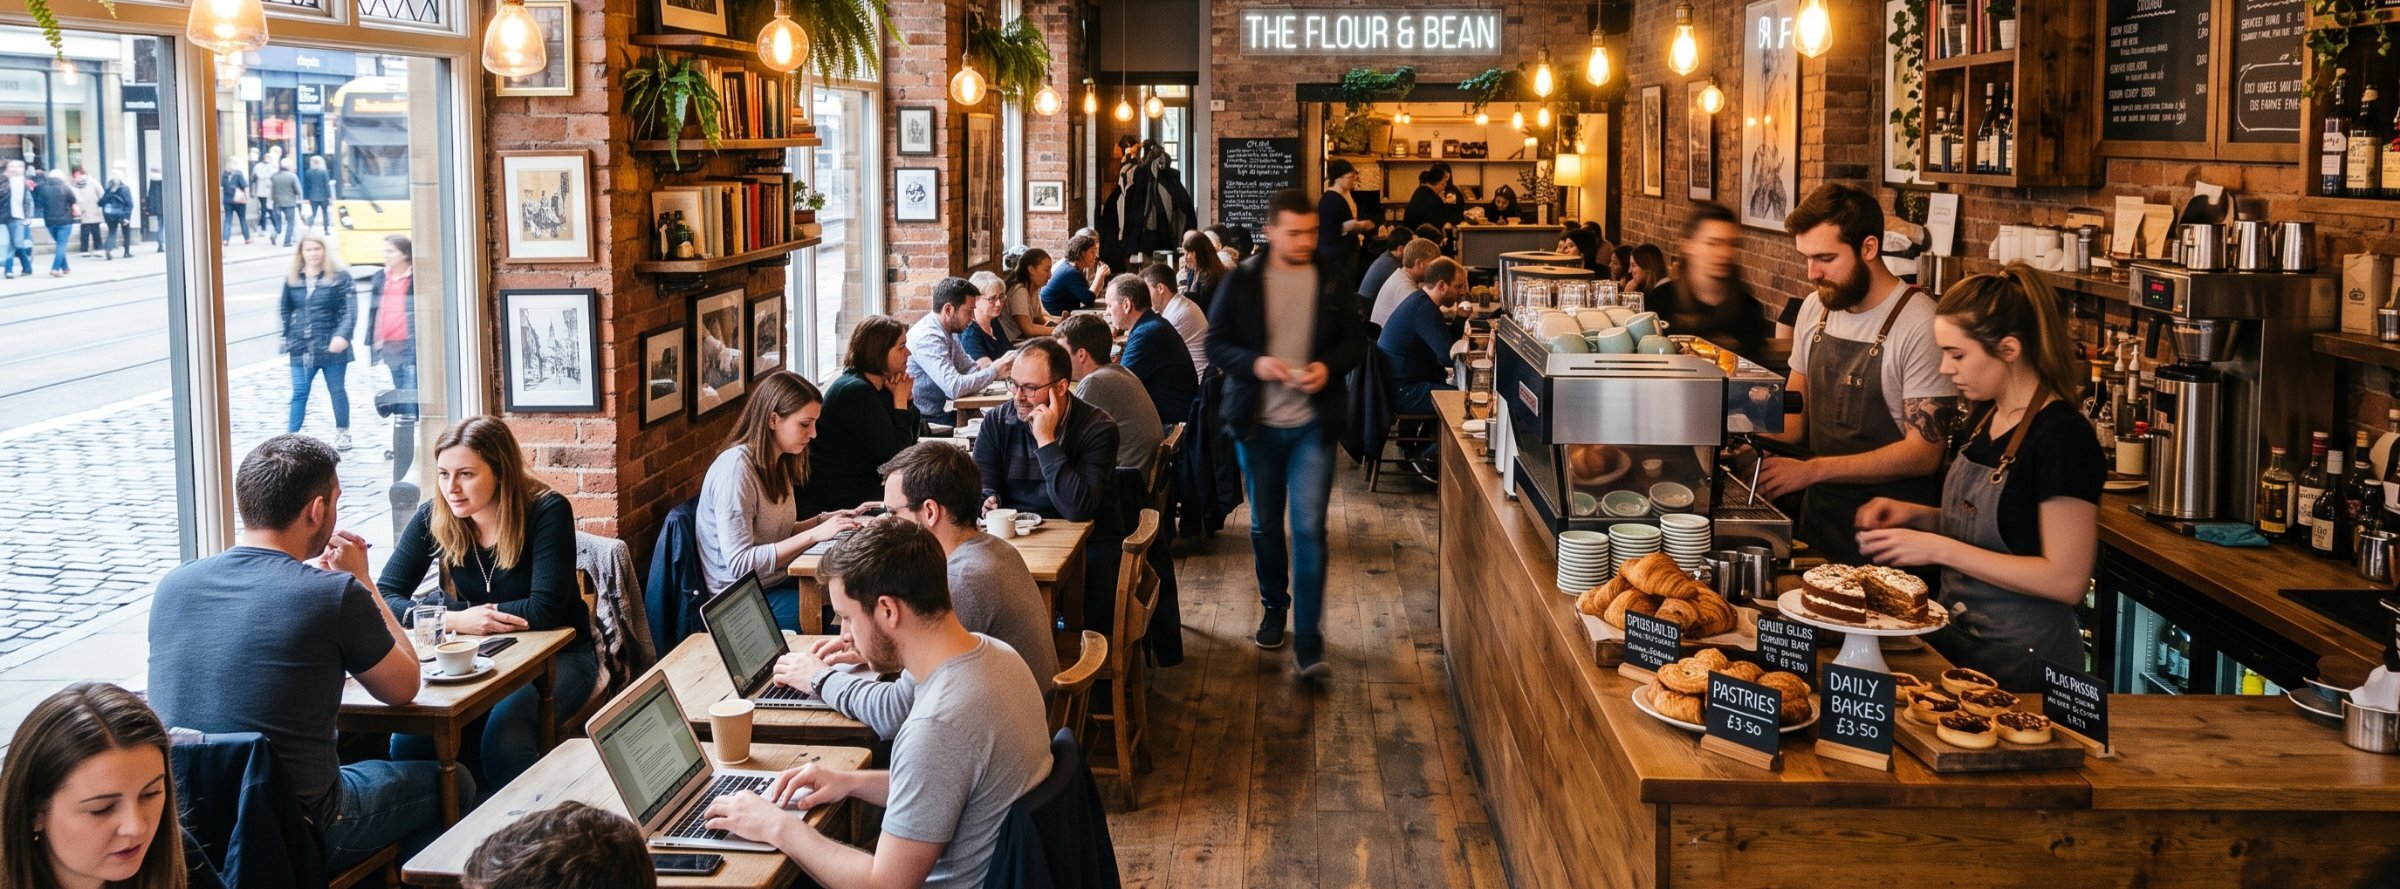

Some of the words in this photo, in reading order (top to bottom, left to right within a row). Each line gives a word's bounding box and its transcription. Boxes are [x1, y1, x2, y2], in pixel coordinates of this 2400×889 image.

[1245, 15, 1297, 49] THE
[1306, 15, 1388, 49] FLOUR
[1397, 15, 1415, 49] &
[1423, 15, 1494, 49] BEAN
[1713, 680, 1776, 715] PASTRIES
[1830, 671, 1879, 698] DAILY
[1831, 695, 1886, 722] BAKES
